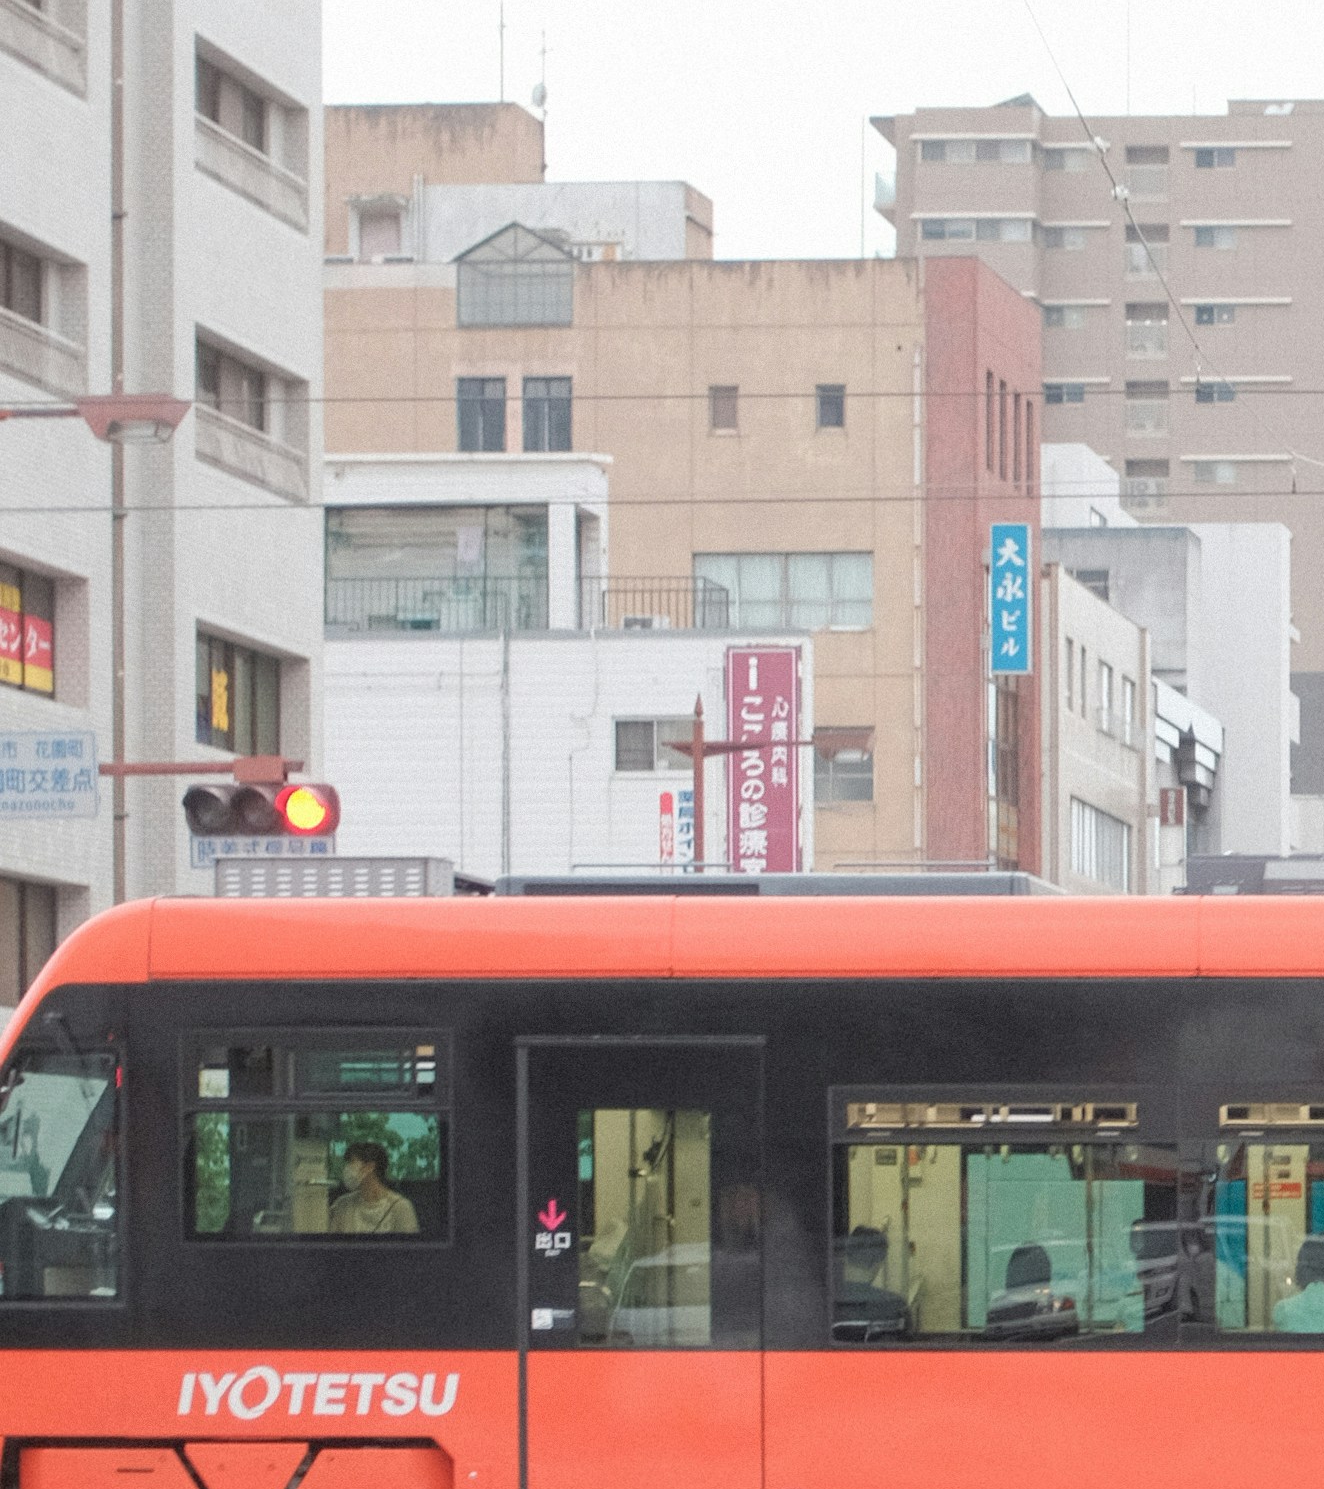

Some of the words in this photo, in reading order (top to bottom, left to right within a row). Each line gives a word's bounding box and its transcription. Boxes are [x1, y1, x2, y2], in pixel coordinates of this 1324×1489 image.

[996, 537, 1025, 657] 大永ビル
[0, 767, 94, 793] 町交差点
[535, 1231, 572, 1250] 出口
[176, 1365, 460, 1420] IYOTETSU
